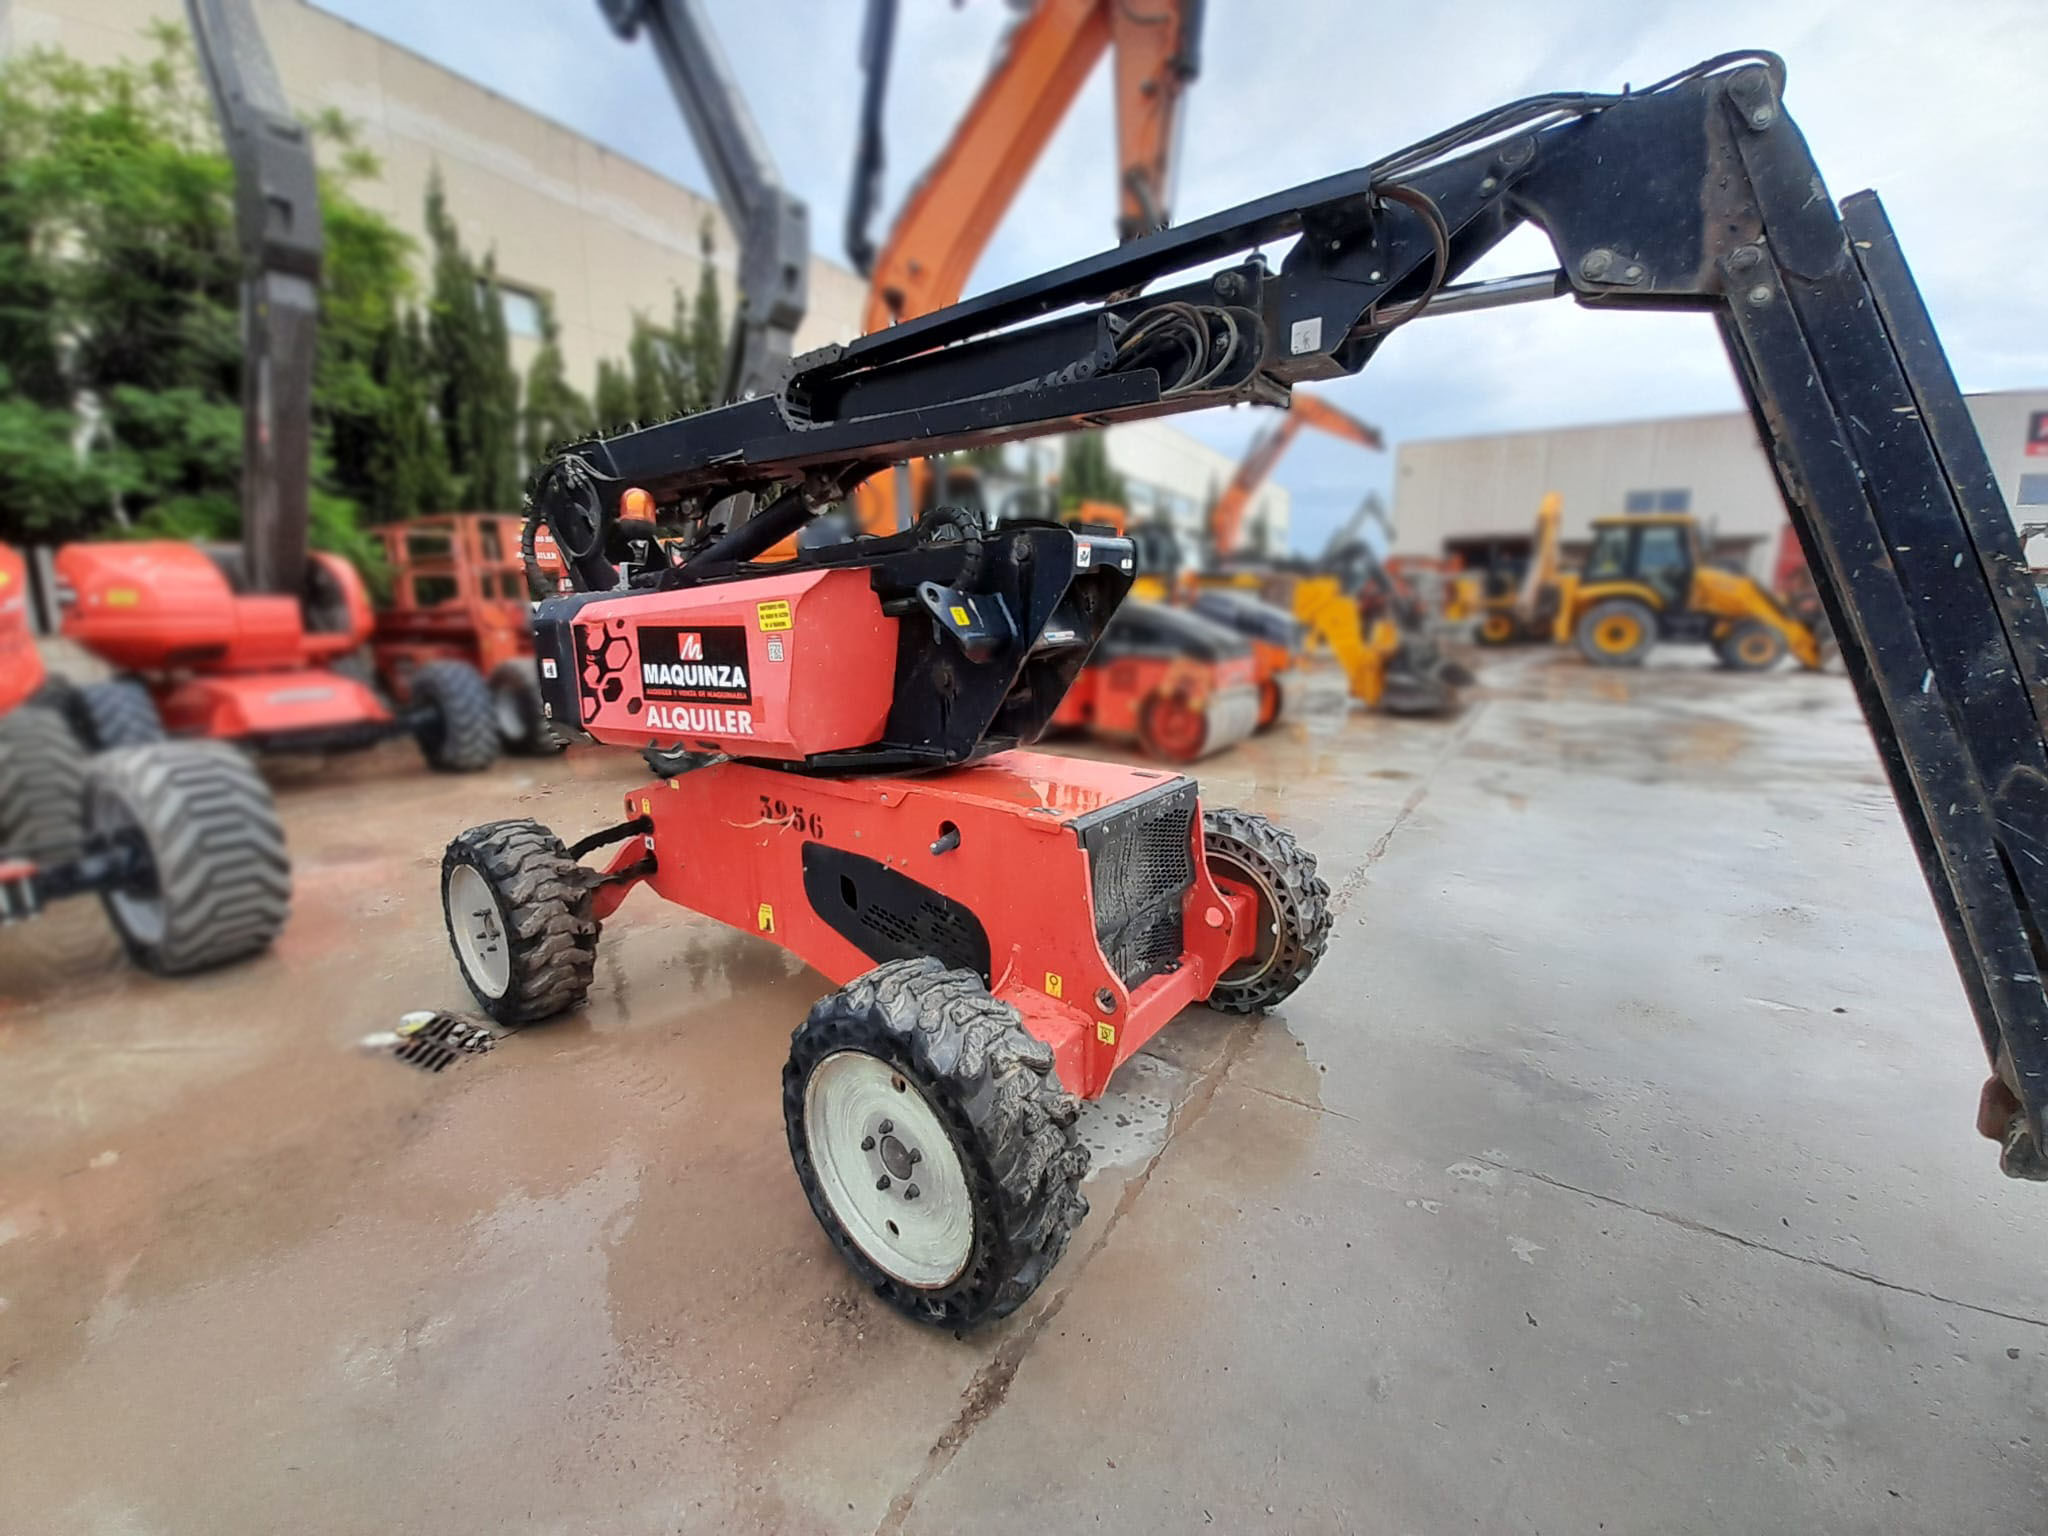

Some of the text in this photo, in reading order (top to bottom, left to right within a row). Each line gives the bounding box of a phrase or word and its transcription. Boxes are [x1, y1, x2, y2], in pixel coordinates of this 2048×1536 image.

[643, 663, 747, 688] MAQUINZA
[646, 705, 754, 734] ALQUILER
[759, 794, 824, 839] 3956
